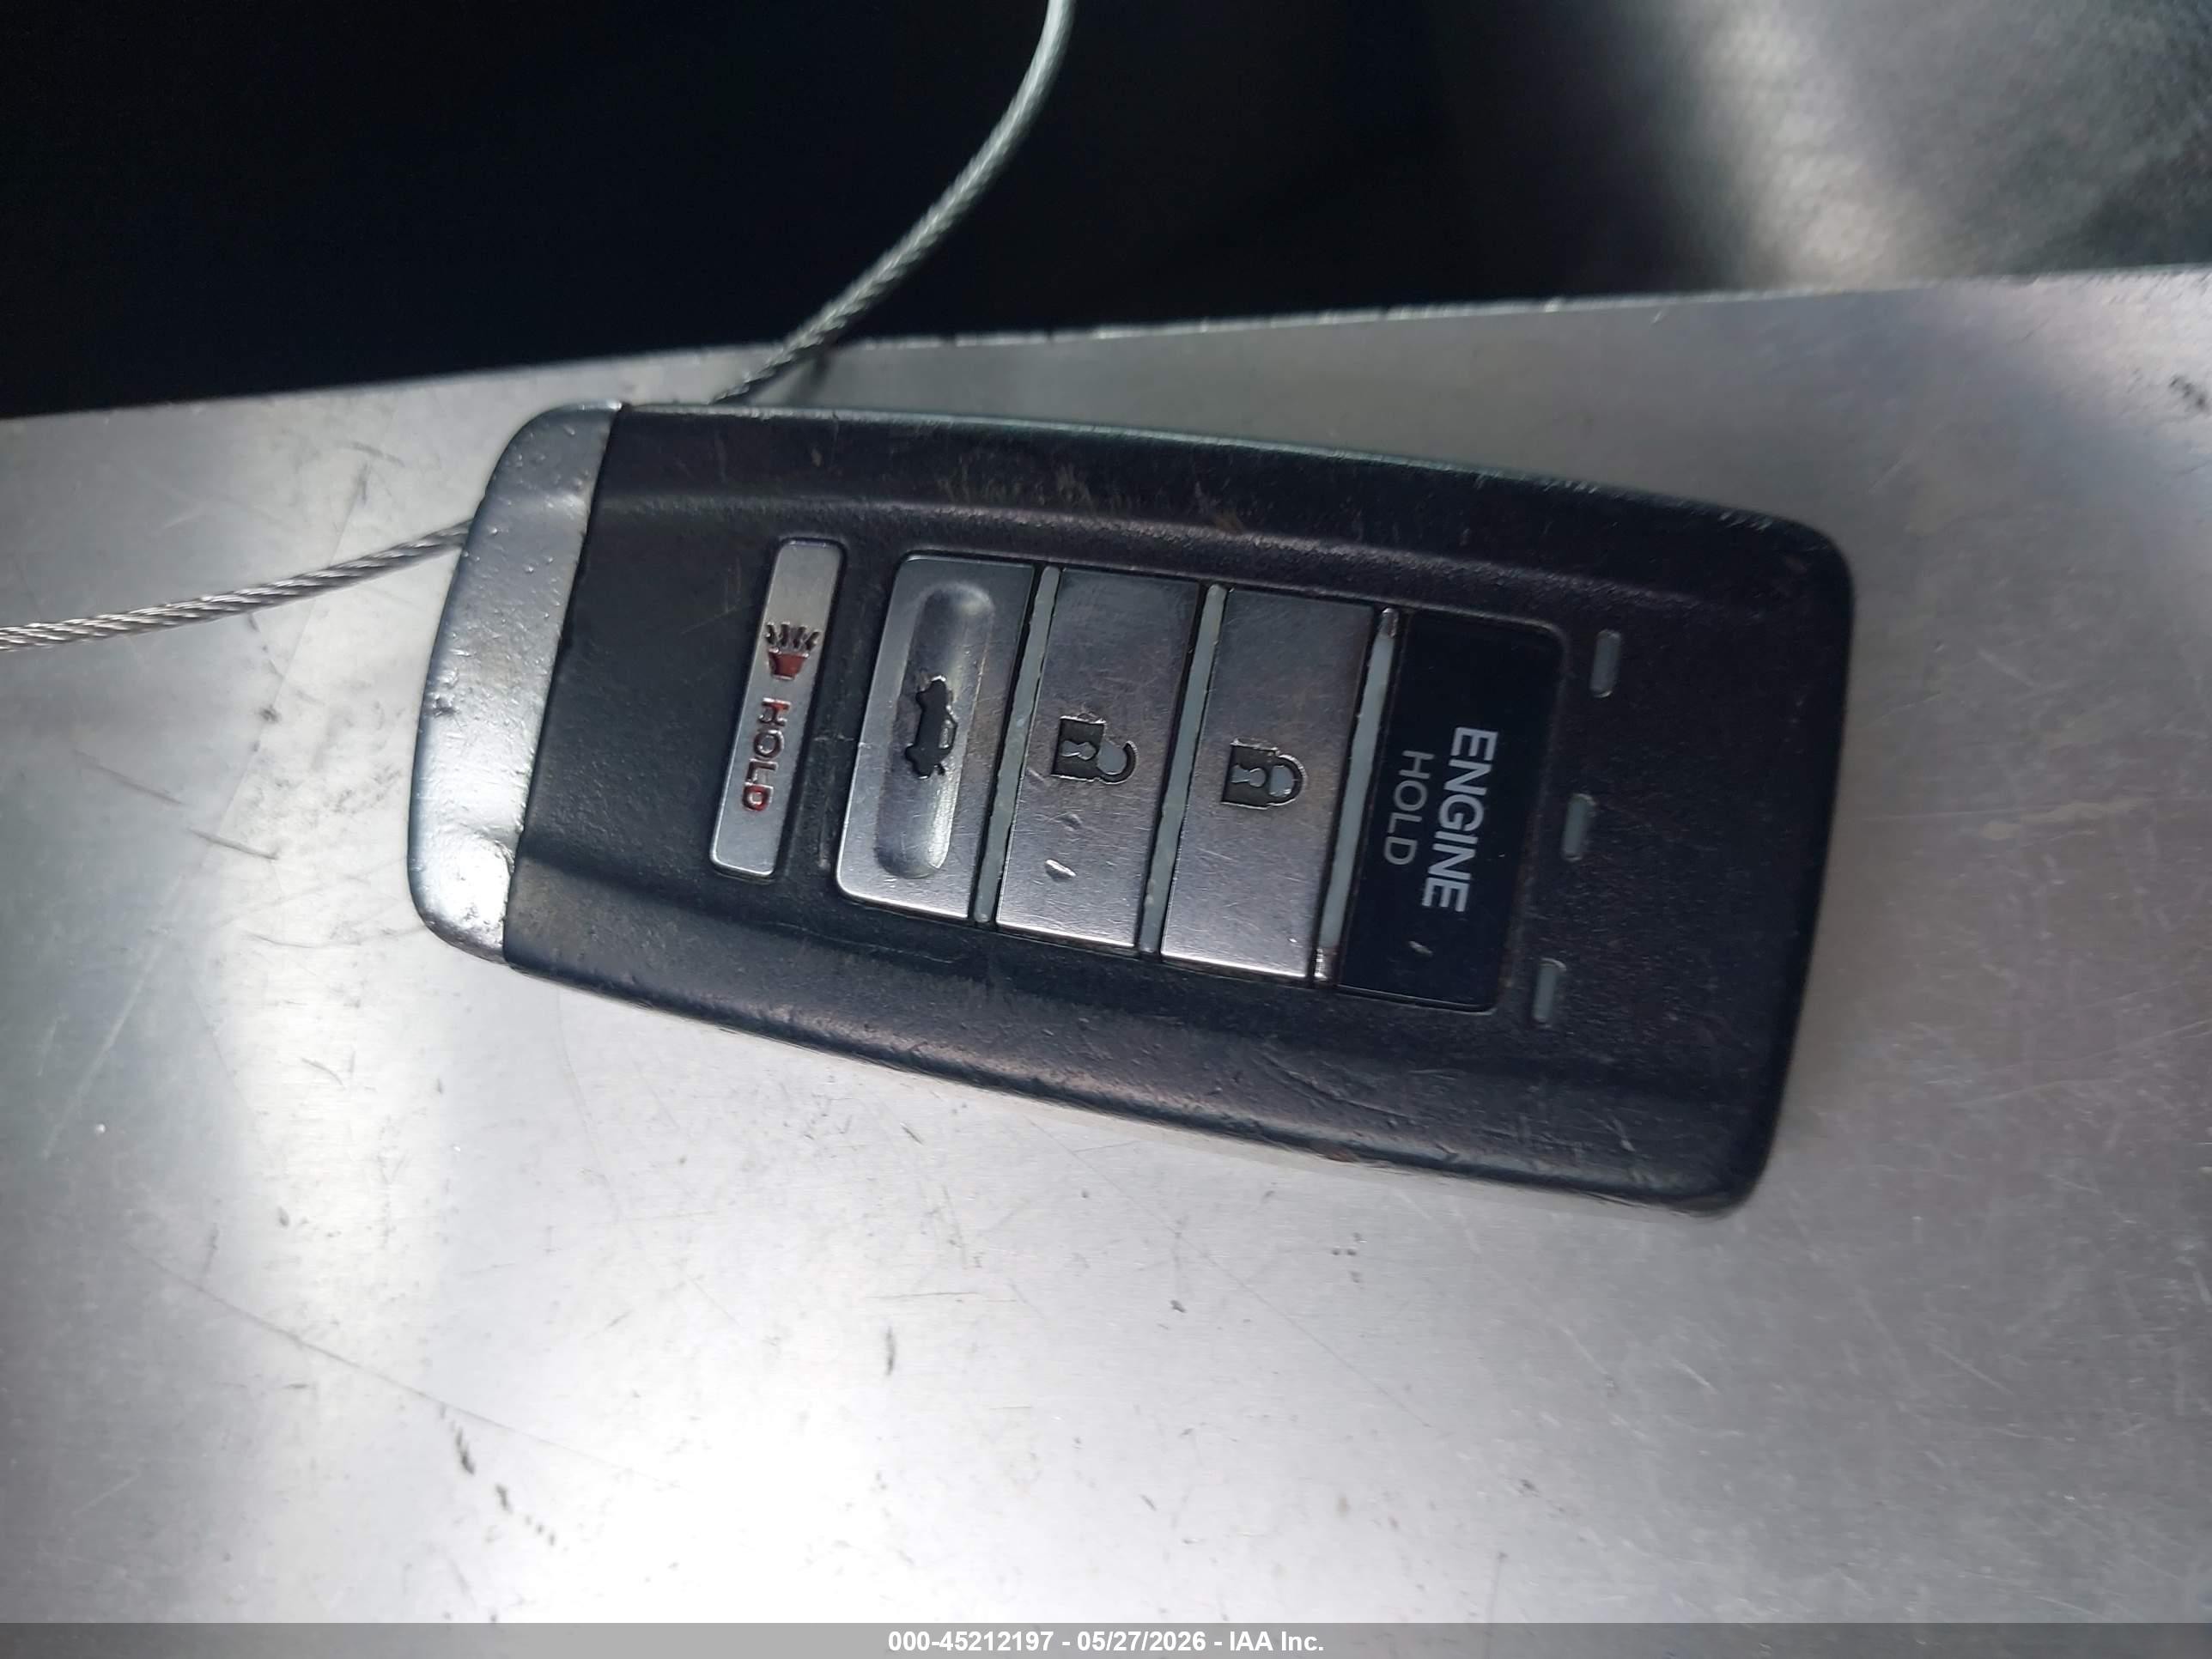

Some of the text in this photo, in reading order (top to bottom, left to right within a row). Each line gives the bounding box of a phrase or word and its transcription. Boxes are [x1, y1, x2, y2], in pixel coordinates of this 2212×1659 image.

[741, 697, 792, 811] HOLD
[1383, 750, 1436, 866] HOLD
[1421, 726, 1498, 913] ENGINE
